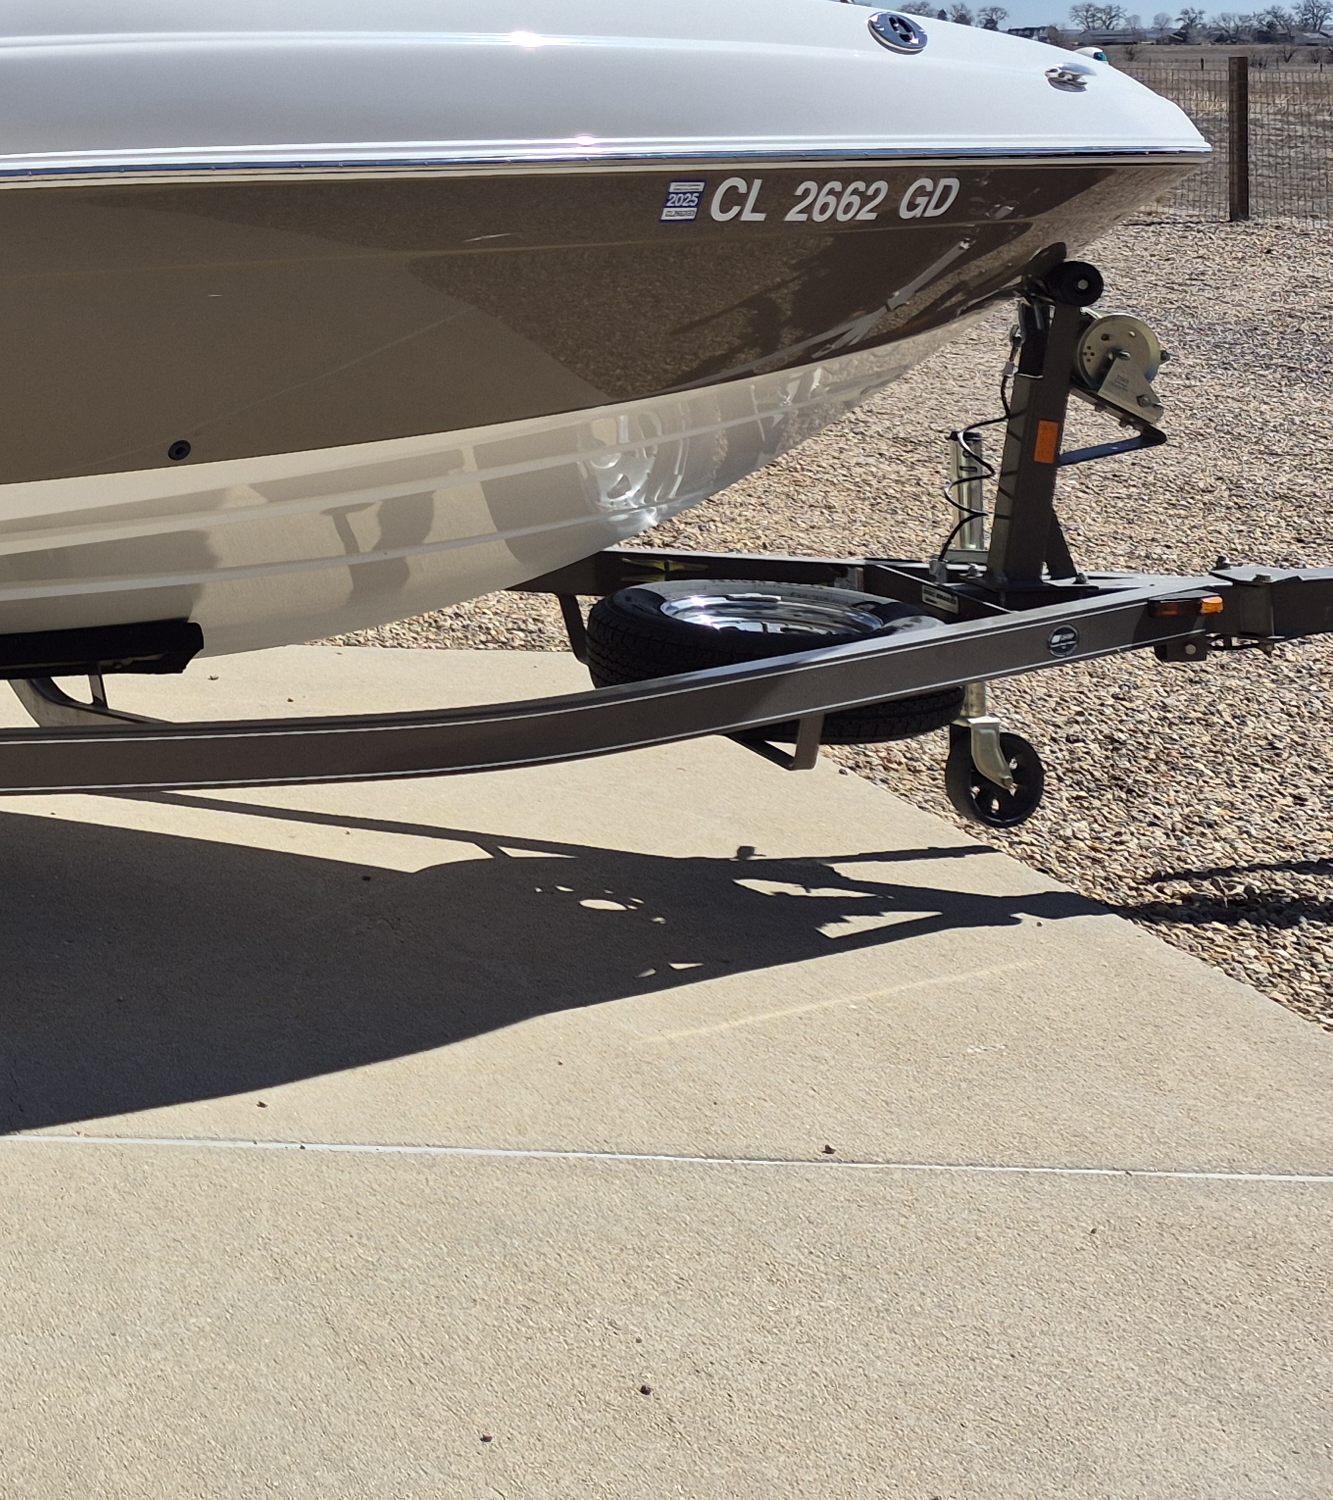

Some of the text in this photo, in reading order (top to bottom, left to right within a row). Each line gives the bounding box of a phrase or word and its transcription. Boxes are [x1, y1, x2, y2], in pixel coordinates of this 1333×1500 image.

[666, 193, 700, 207] 2025
[710, 177, 960, 222] CL 2662 GD
